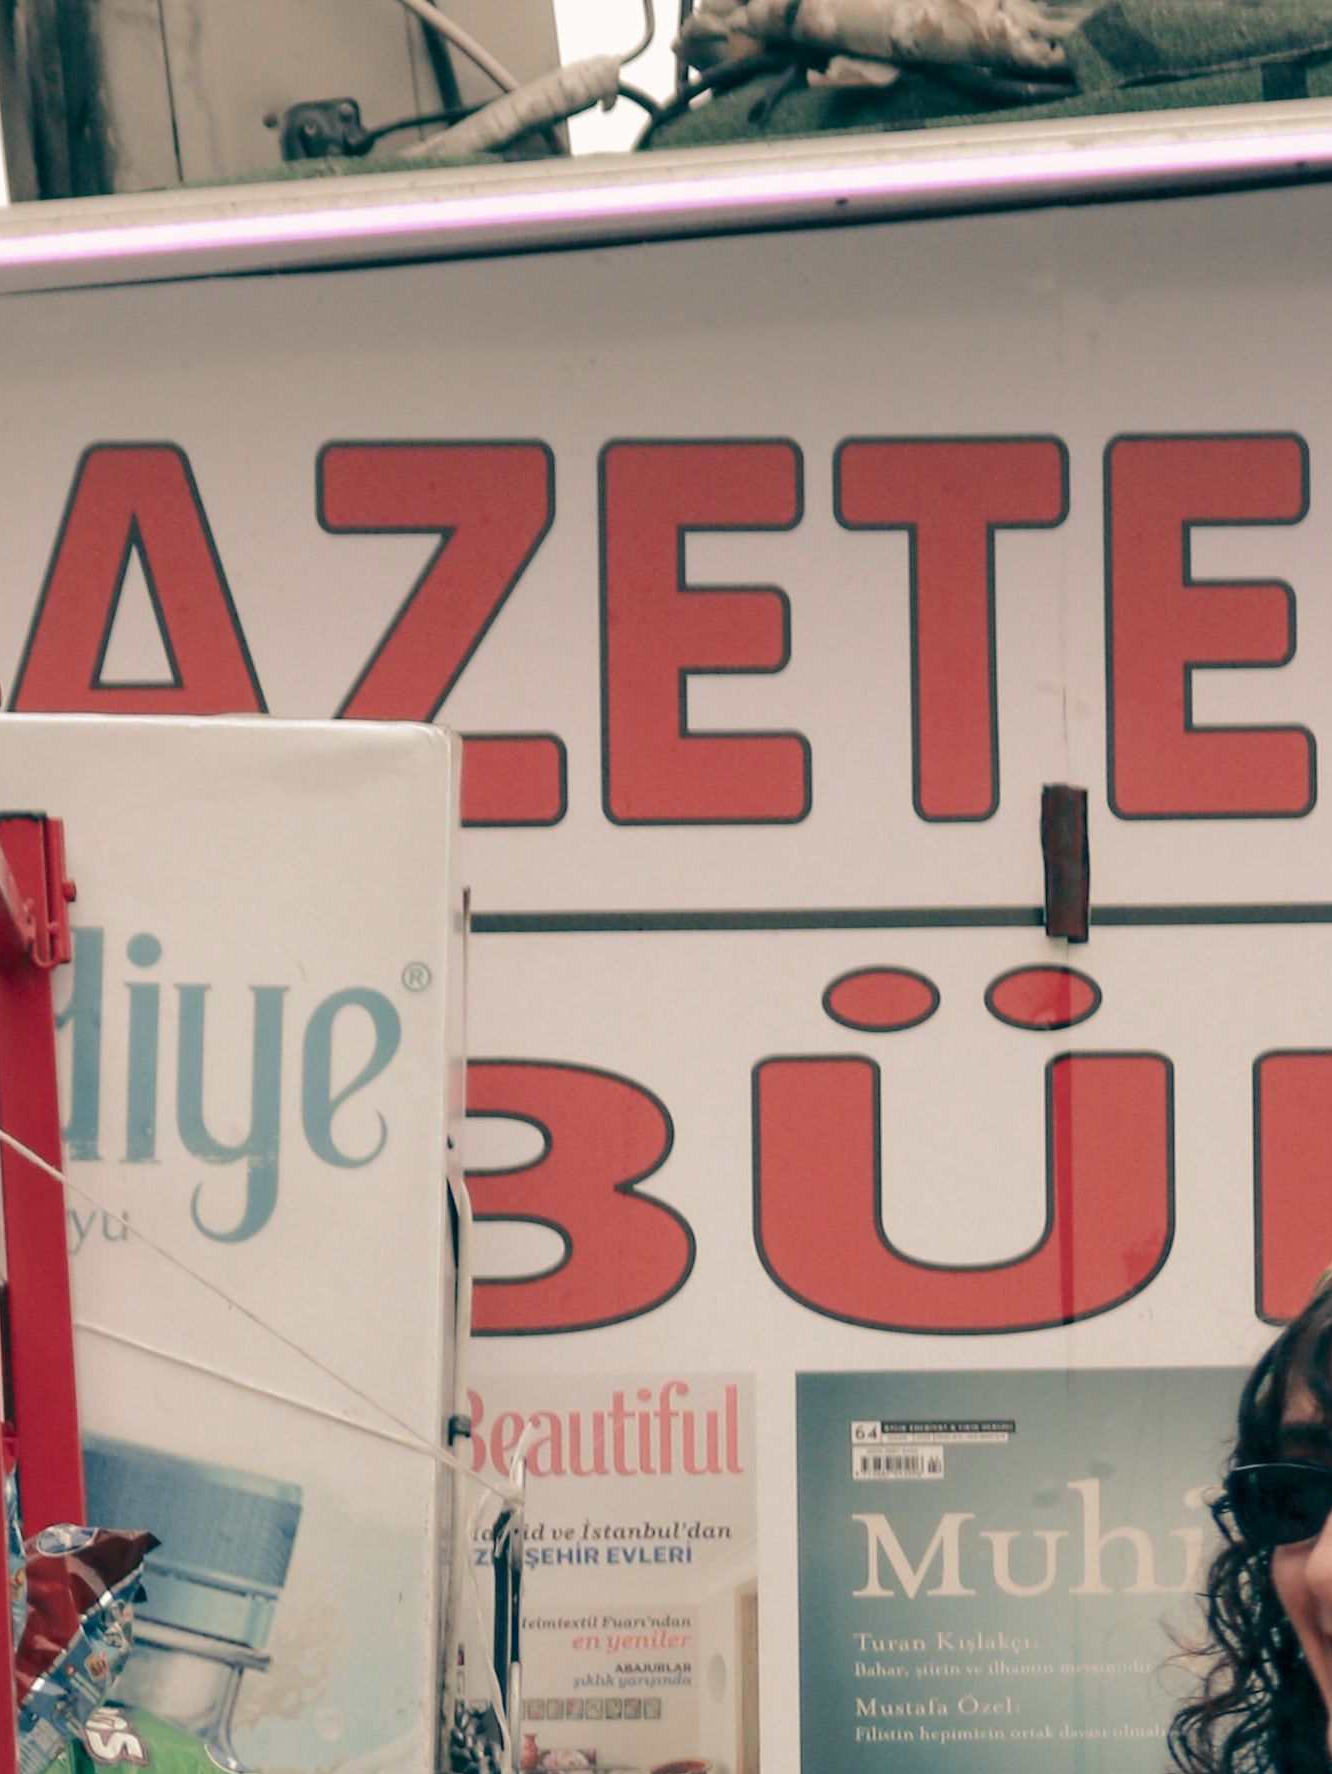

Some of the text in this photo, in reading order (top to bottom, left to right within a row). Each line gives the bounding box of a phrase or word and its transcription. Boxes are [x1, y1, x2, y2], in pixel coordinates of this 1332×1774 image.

[552, 1527, 574, 1541] ve
[525, 1543, 693, 1569] ŞEHİR EVLERİ
[522, 1616, 597, 1630] eimtextil
[572, 1631, 692, 1654] en yeniler
[853, 1632, 926, 1651] Turan
[615, 1663, 692, 1673] ABAJURLAR
[855, 1697, 948, 1717] Mustafa
[855, 1725, 914, 1742] Filistin
[1011, 1725, 1054, 1740] ortak
